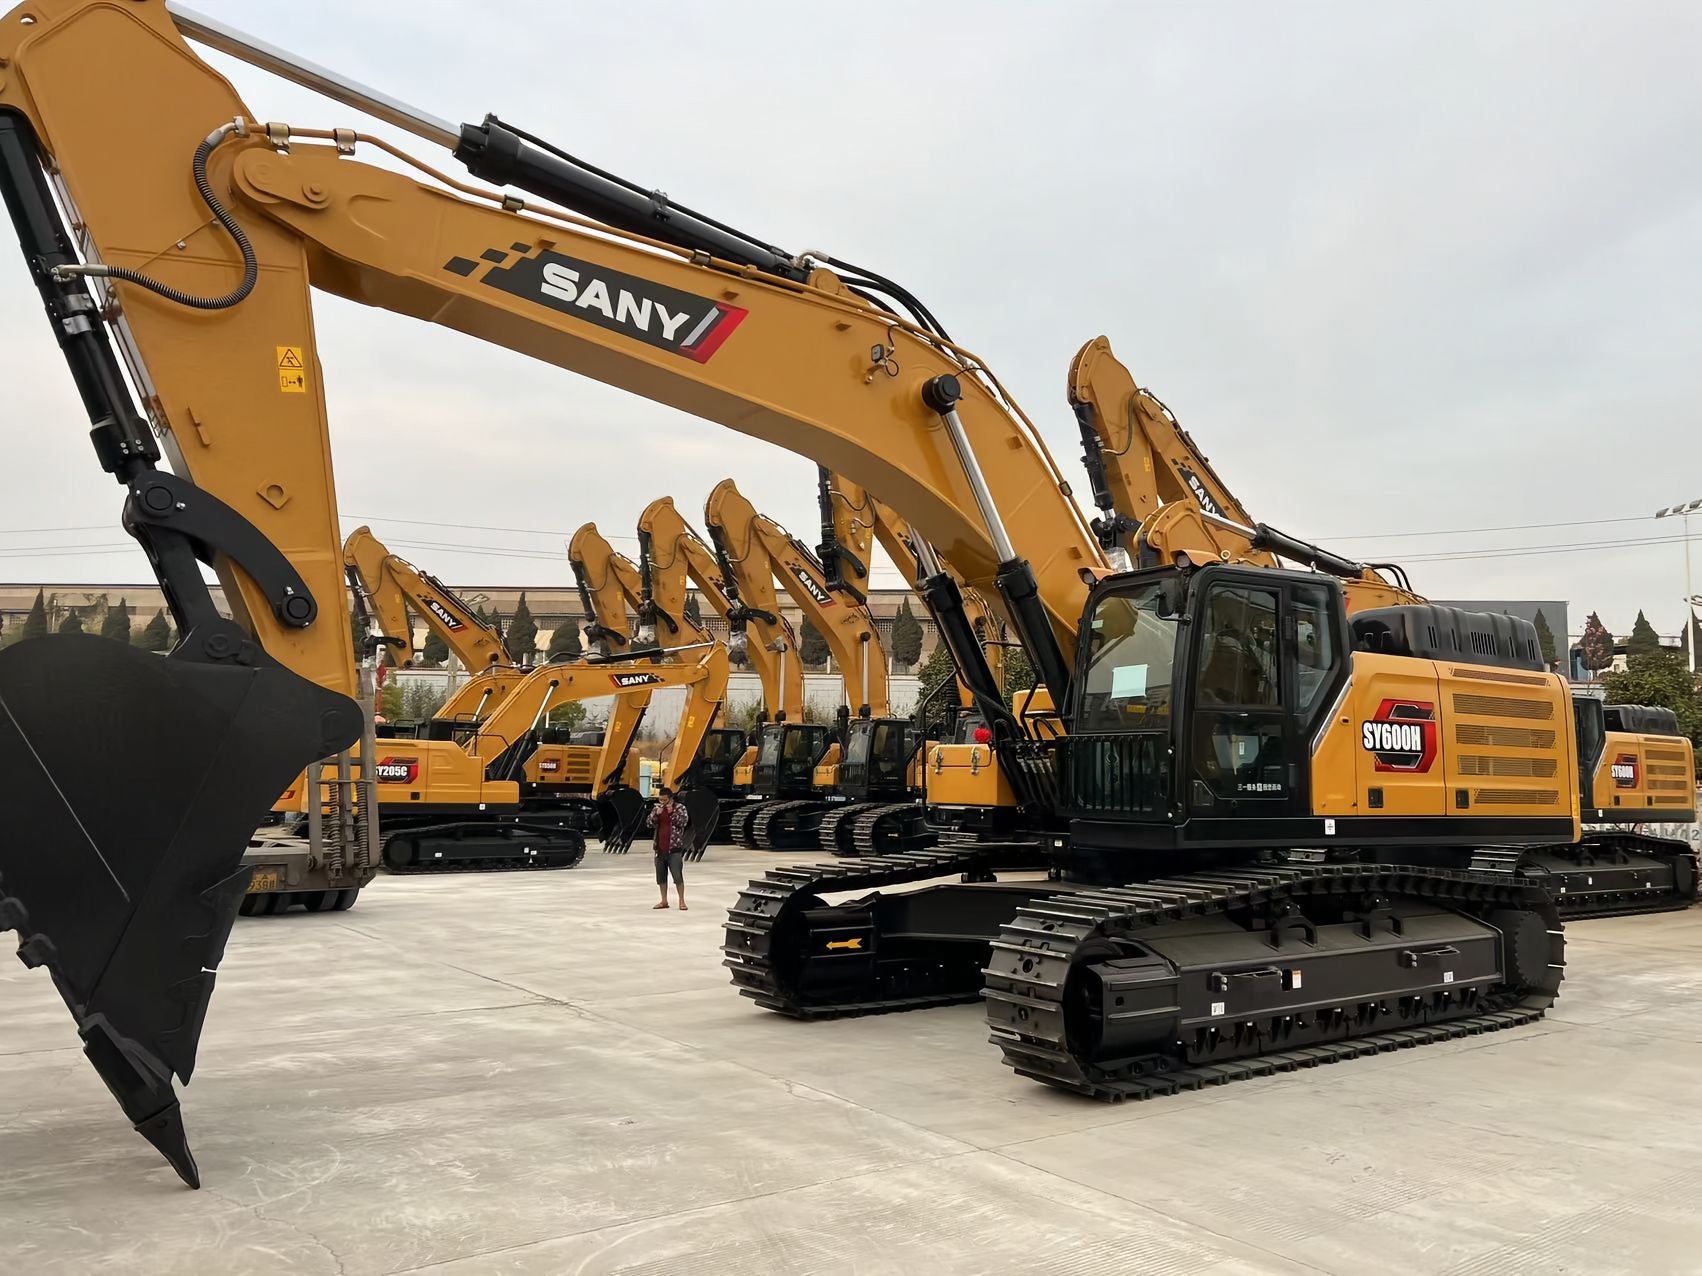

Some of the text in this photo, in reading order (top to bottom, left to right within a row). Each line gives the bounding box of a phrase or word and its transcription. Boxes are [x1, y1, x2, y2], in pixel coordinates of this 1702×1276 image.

[541, 262, 690, 341] SANY
[798, 571, 825, 600] SANY
[430, 602, 457, 627] SANY
[621, 674, 649, 686] SANY
[1363, 722, 1421, 751] SY600H
